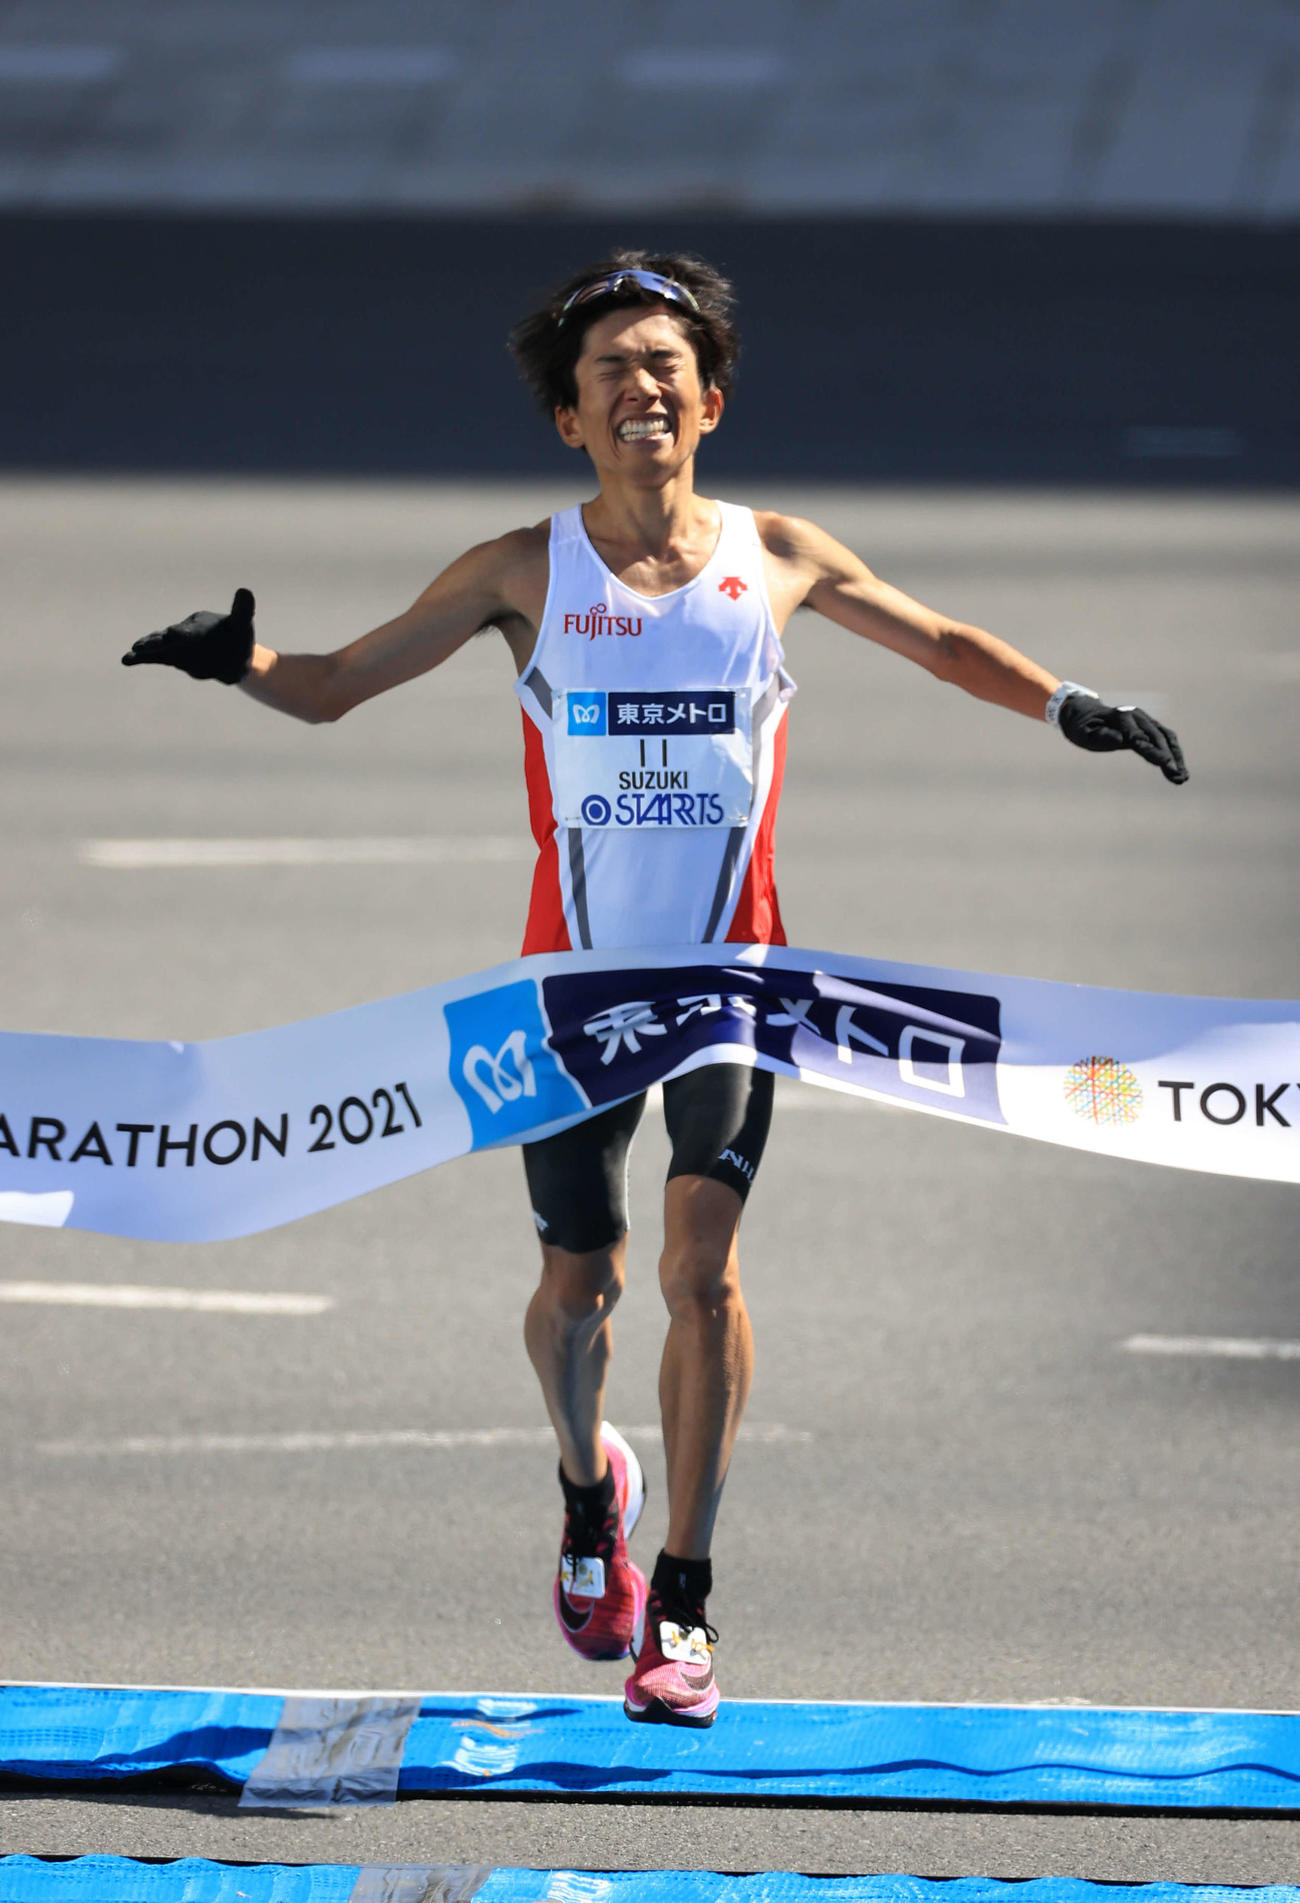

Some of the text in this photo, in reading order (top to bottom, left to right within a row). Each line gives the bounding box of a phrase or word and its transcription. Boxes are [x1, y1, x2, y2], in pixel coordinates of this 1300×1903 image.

[564, 603, 642, 640] FUJITSU
[616, 703, 726, 725] 東京メトロ
[640, 739, 667, 767] 11
[619, 771, 688, 790] SUZUKI
[308, 1082, 422, 1153] 2021
[1158, 1080, 1300, 1127] TOK
